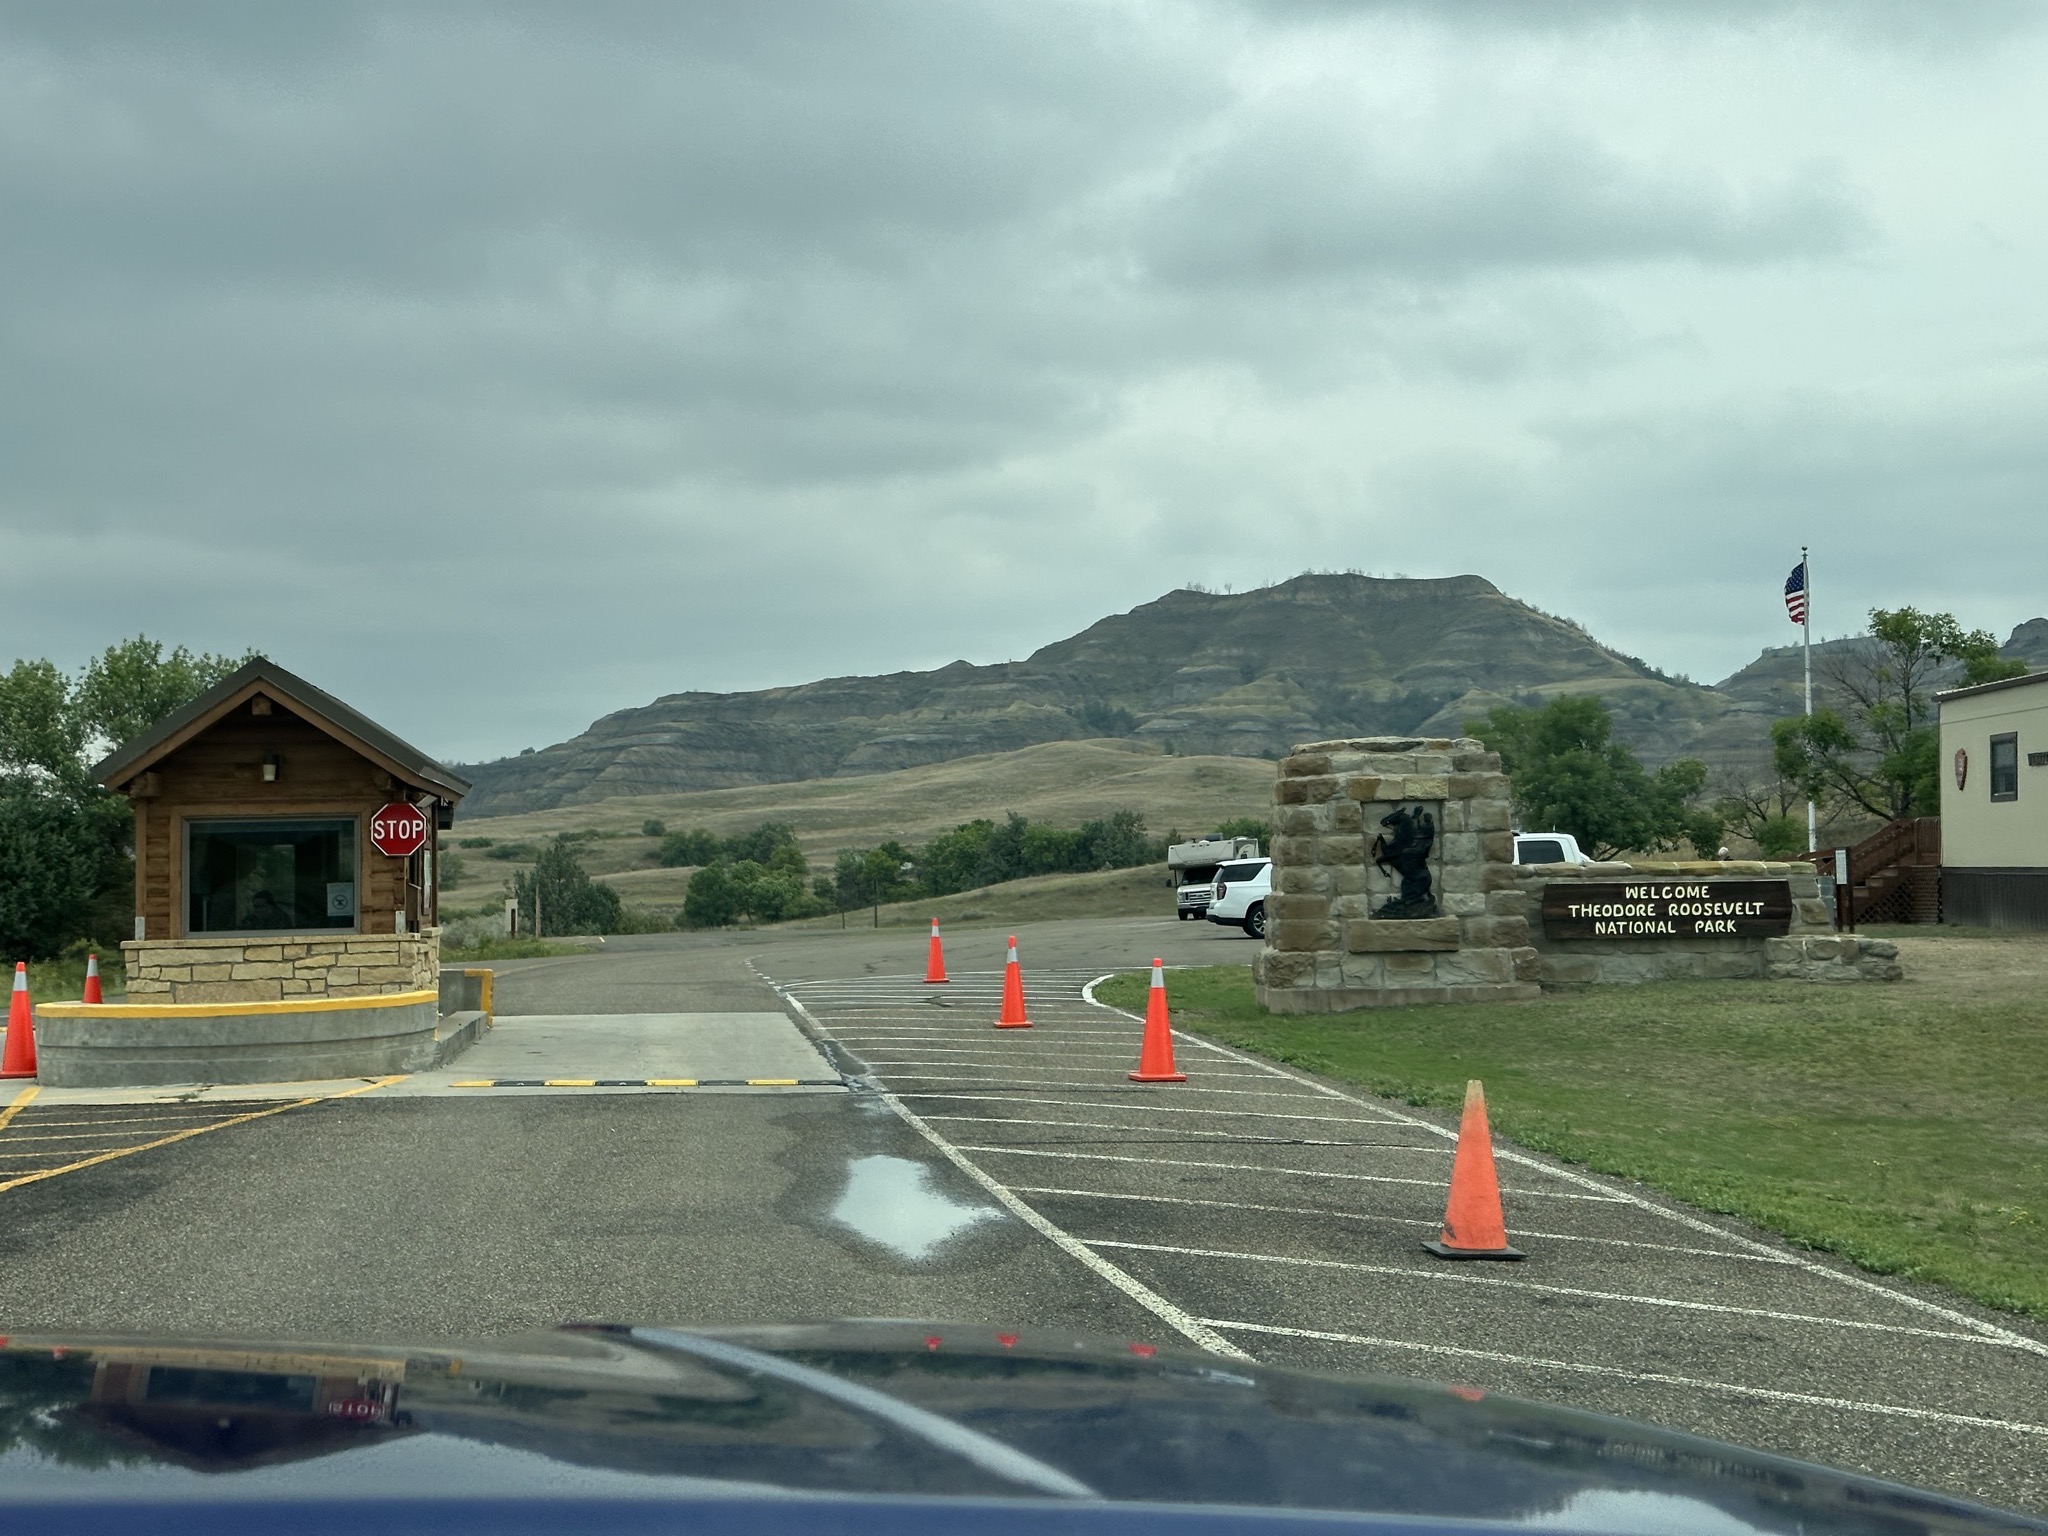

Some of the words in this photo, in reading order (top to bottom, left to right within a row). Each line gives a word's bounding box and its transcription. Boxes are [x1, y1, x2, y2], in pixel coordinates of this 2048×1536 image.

[373, 819, 424, 840] STOP
[1625, 885, 1711, 900] WELCOME
[1568, 903, 1656, 918] THEODORE
[1668, 901, 1765, 916] ROOSEVELT
[1595, 920, 1677, 935] NATIONAL
[1694, 919, 1737, 934] PARK
